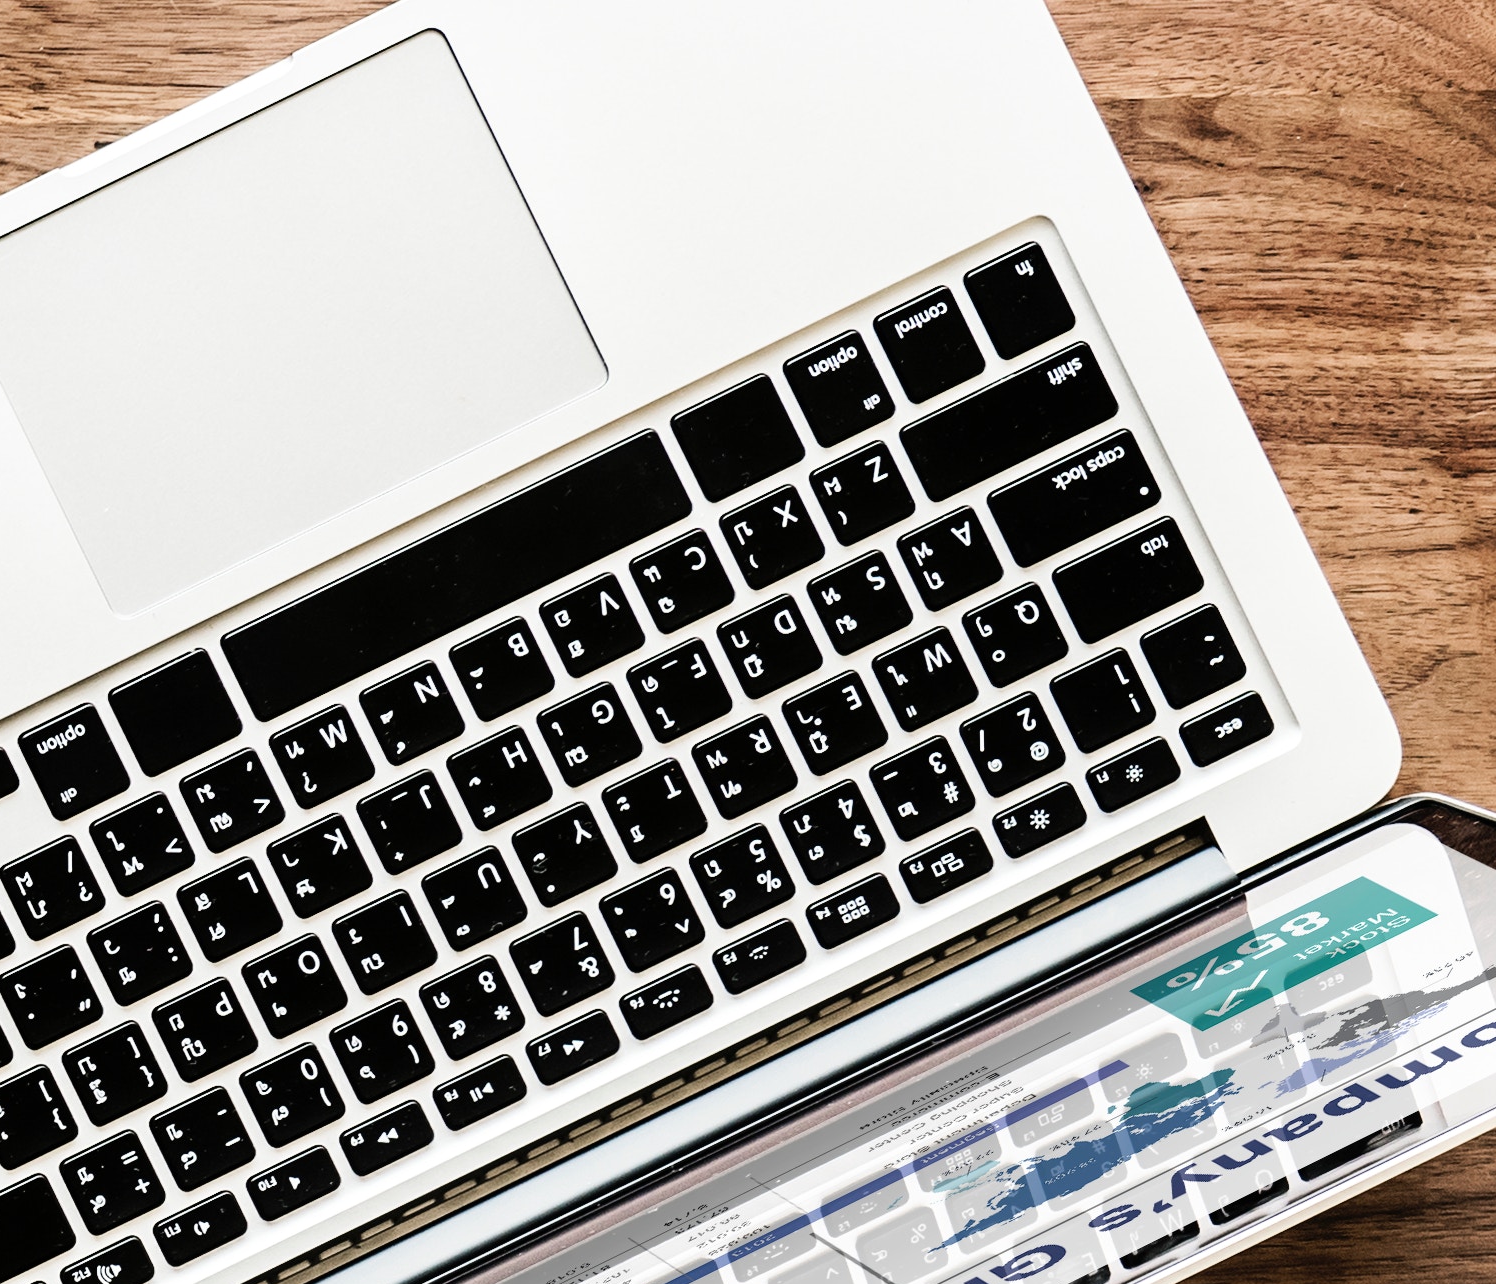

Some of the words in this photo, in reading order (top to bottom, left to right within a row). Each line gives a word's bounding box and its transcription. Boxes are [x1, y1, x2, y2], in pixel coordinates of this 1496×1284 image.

[894, 302, 948, 339] control
[808, 346, 857, 377] option
[1047, 357, 1083, 386] shift
[1086, 446, 1125, 472] caps
[1051, 464, 1088, 491] lock
[1140, 534, 1169, 556] tab
[1214, 718, 1243, 739] esc
[1292, 907, 1400, 961] Market
[1329, 915, 1412, 960] Stock
[1166, 910, 1331, 992] 85%
